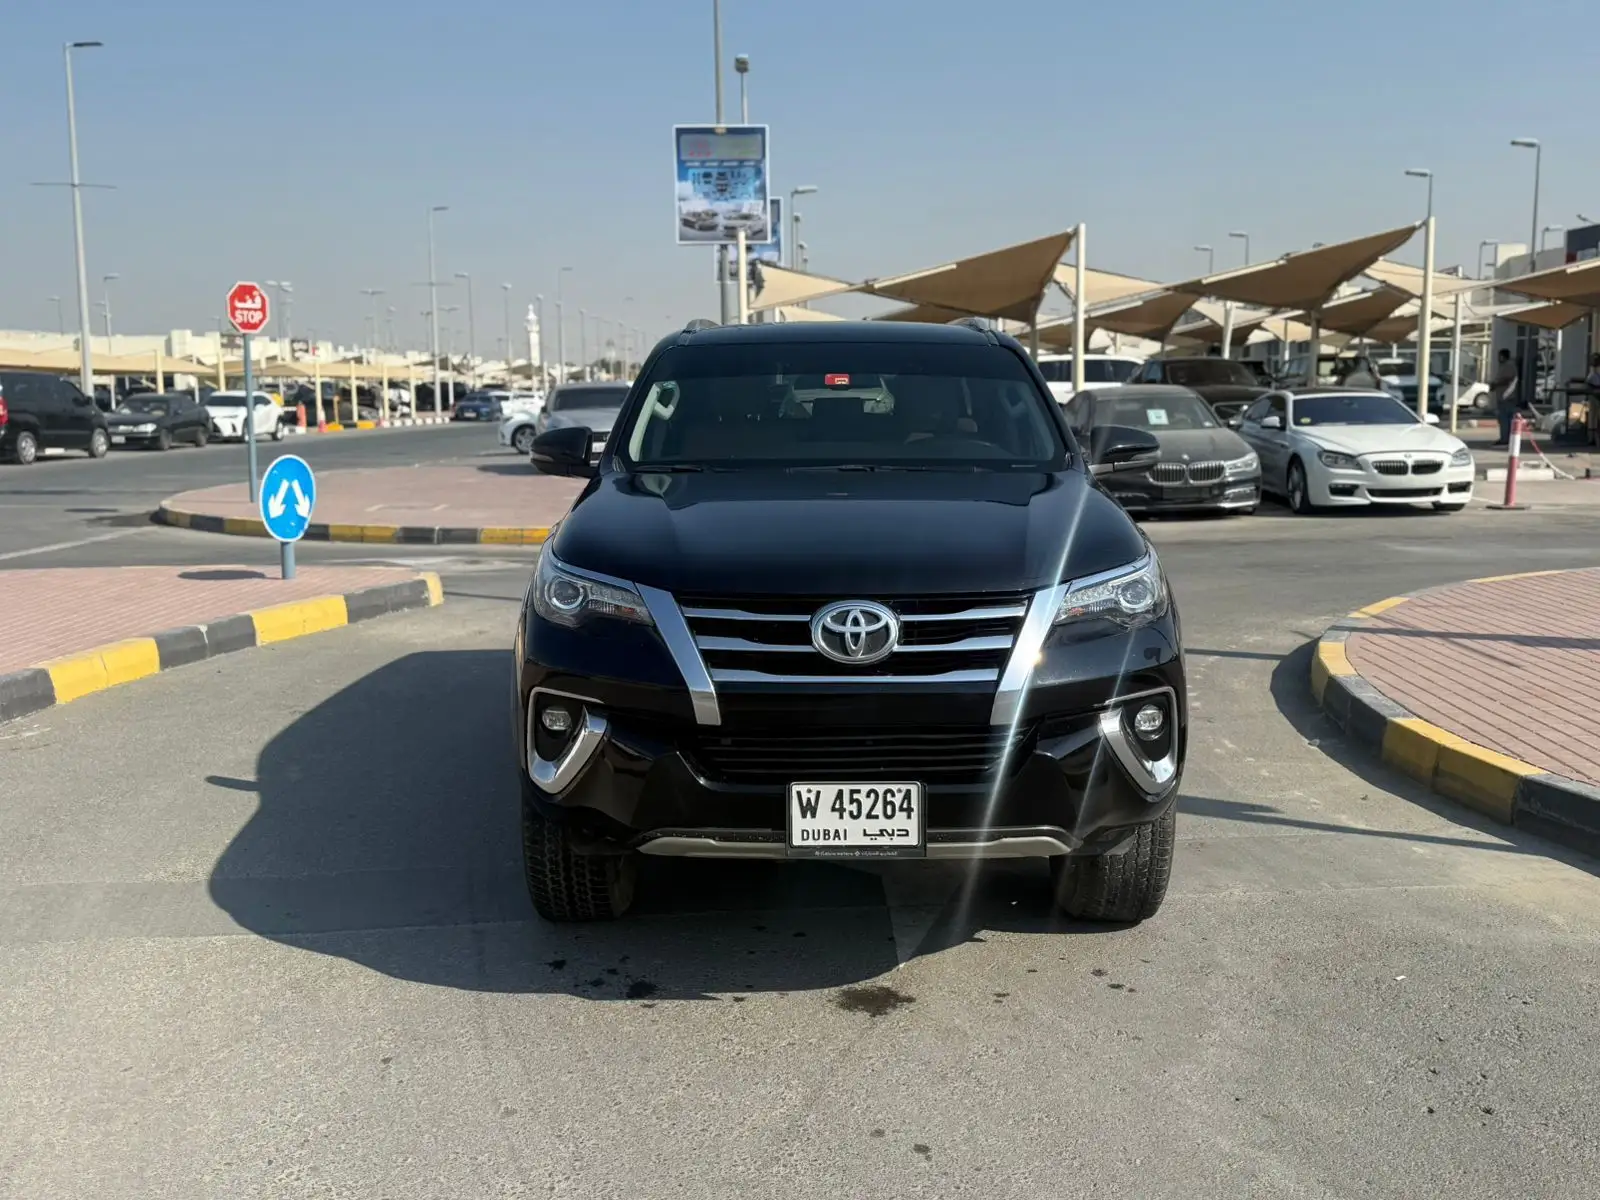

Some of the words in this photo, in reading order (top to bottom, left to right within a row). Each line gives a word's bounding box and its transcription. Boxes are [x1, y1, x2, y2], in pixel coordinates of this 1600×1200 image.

[234, 291, 262, 309] قف
[235, 310, 263, 323] STOP
[796, 790, 821, 819] W
[831, 788, 914, 820] 45264
[801, 829, 847, 841] DUBAI
[863, 828, 909, 841] دبي
